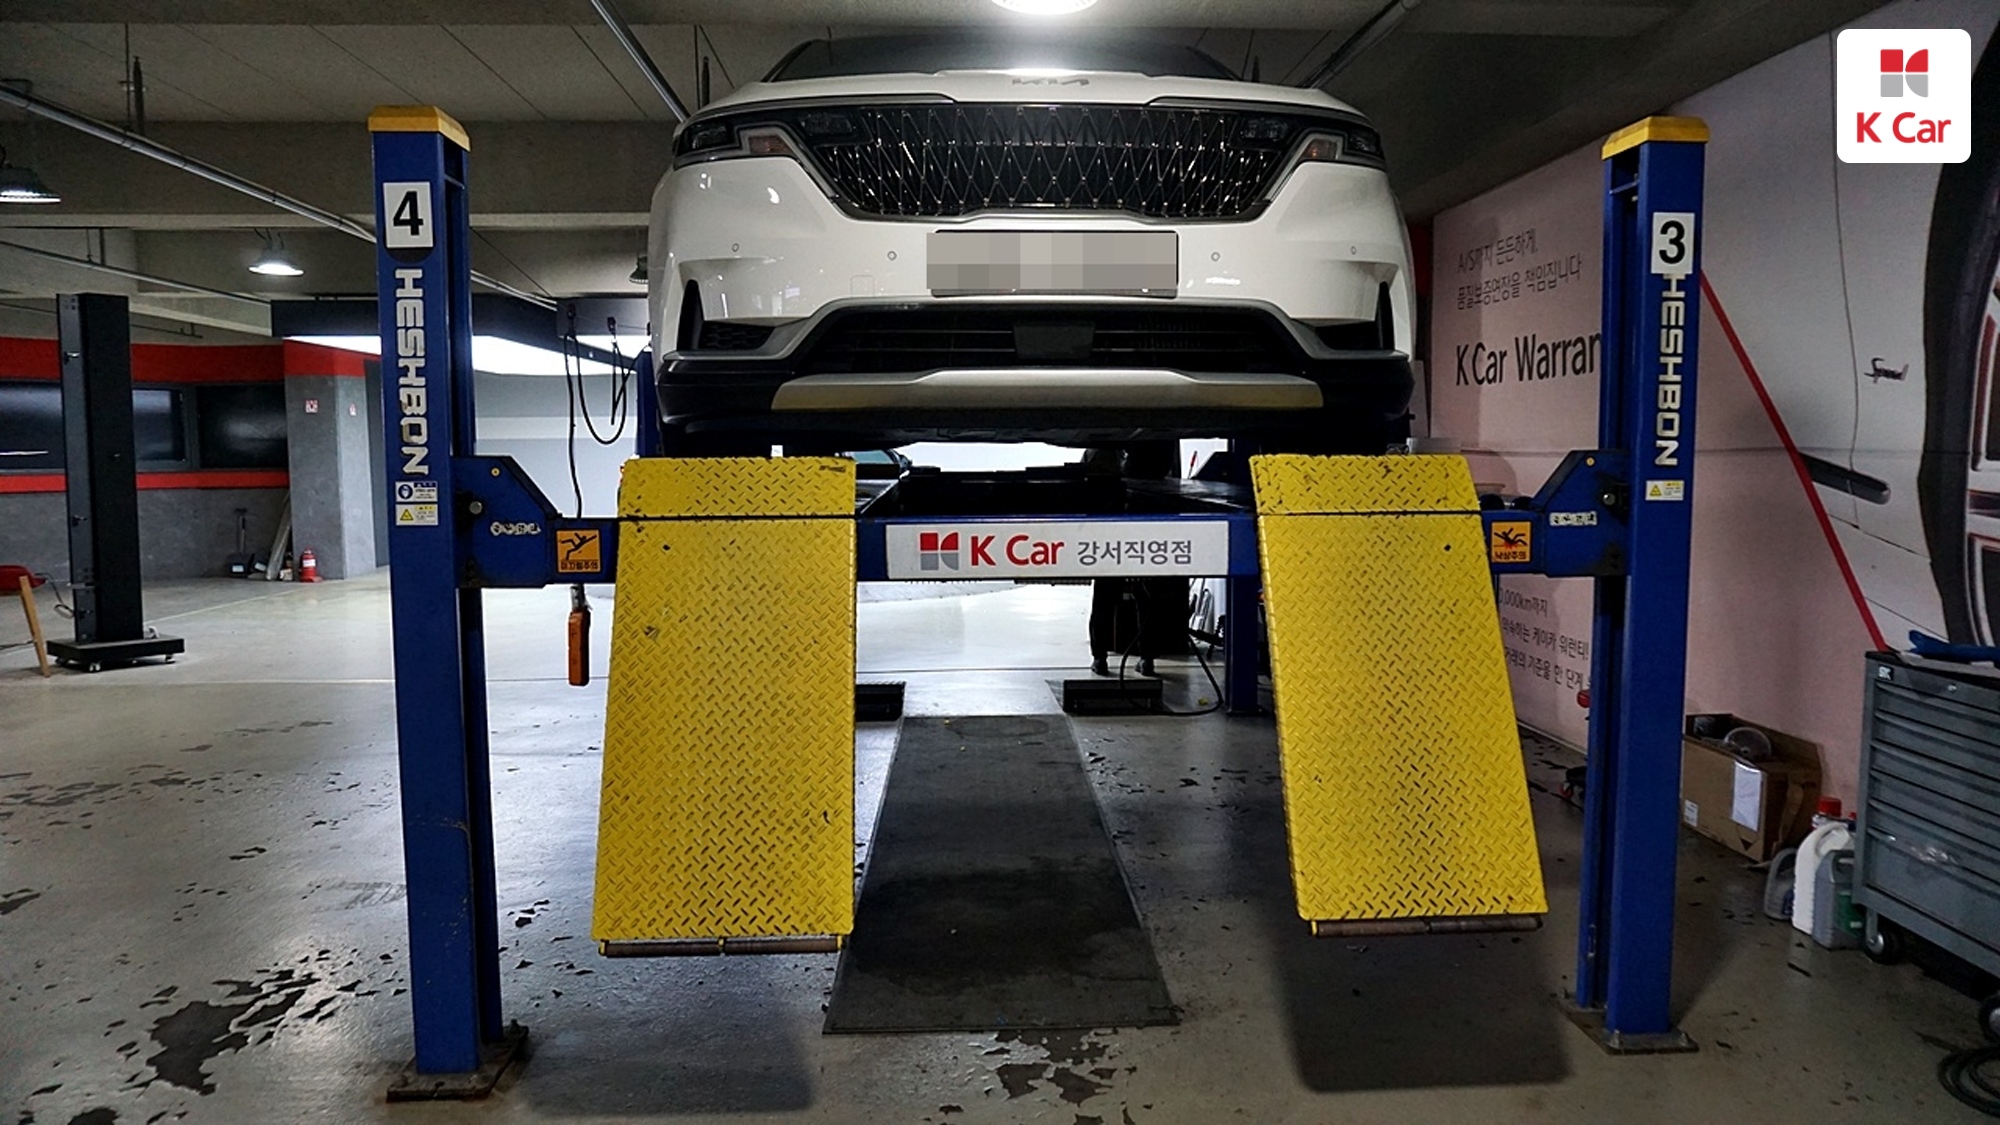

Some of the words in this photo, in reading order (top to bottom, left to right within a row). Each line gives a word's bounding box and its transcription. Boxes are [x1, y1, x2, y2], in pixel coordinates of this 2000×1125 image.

[393, 190, 424, 236] 4
[1659, 220, 1686, 264] 3
[1457, 271, 1521, 310] 품질보증연장을
[1525, 253, 1582, 292] 책임집니다
[394, 268, 429, 475] HESHBON
[1456, 344, 1469, 386] K
[1472, 342, 1507, 385] Car
[1654, 273, 1686, 466] HESHBON
[970, 535, 996, 566] K
[1006, 534, 1064, 565] Car
[1077, 539, 1192, 566] 강서직영점
[1532, 627, 1556, 651] 케이카
[1528, 655, 1550, 681] 기준을
[1554, 664, 1563, 685] 한
